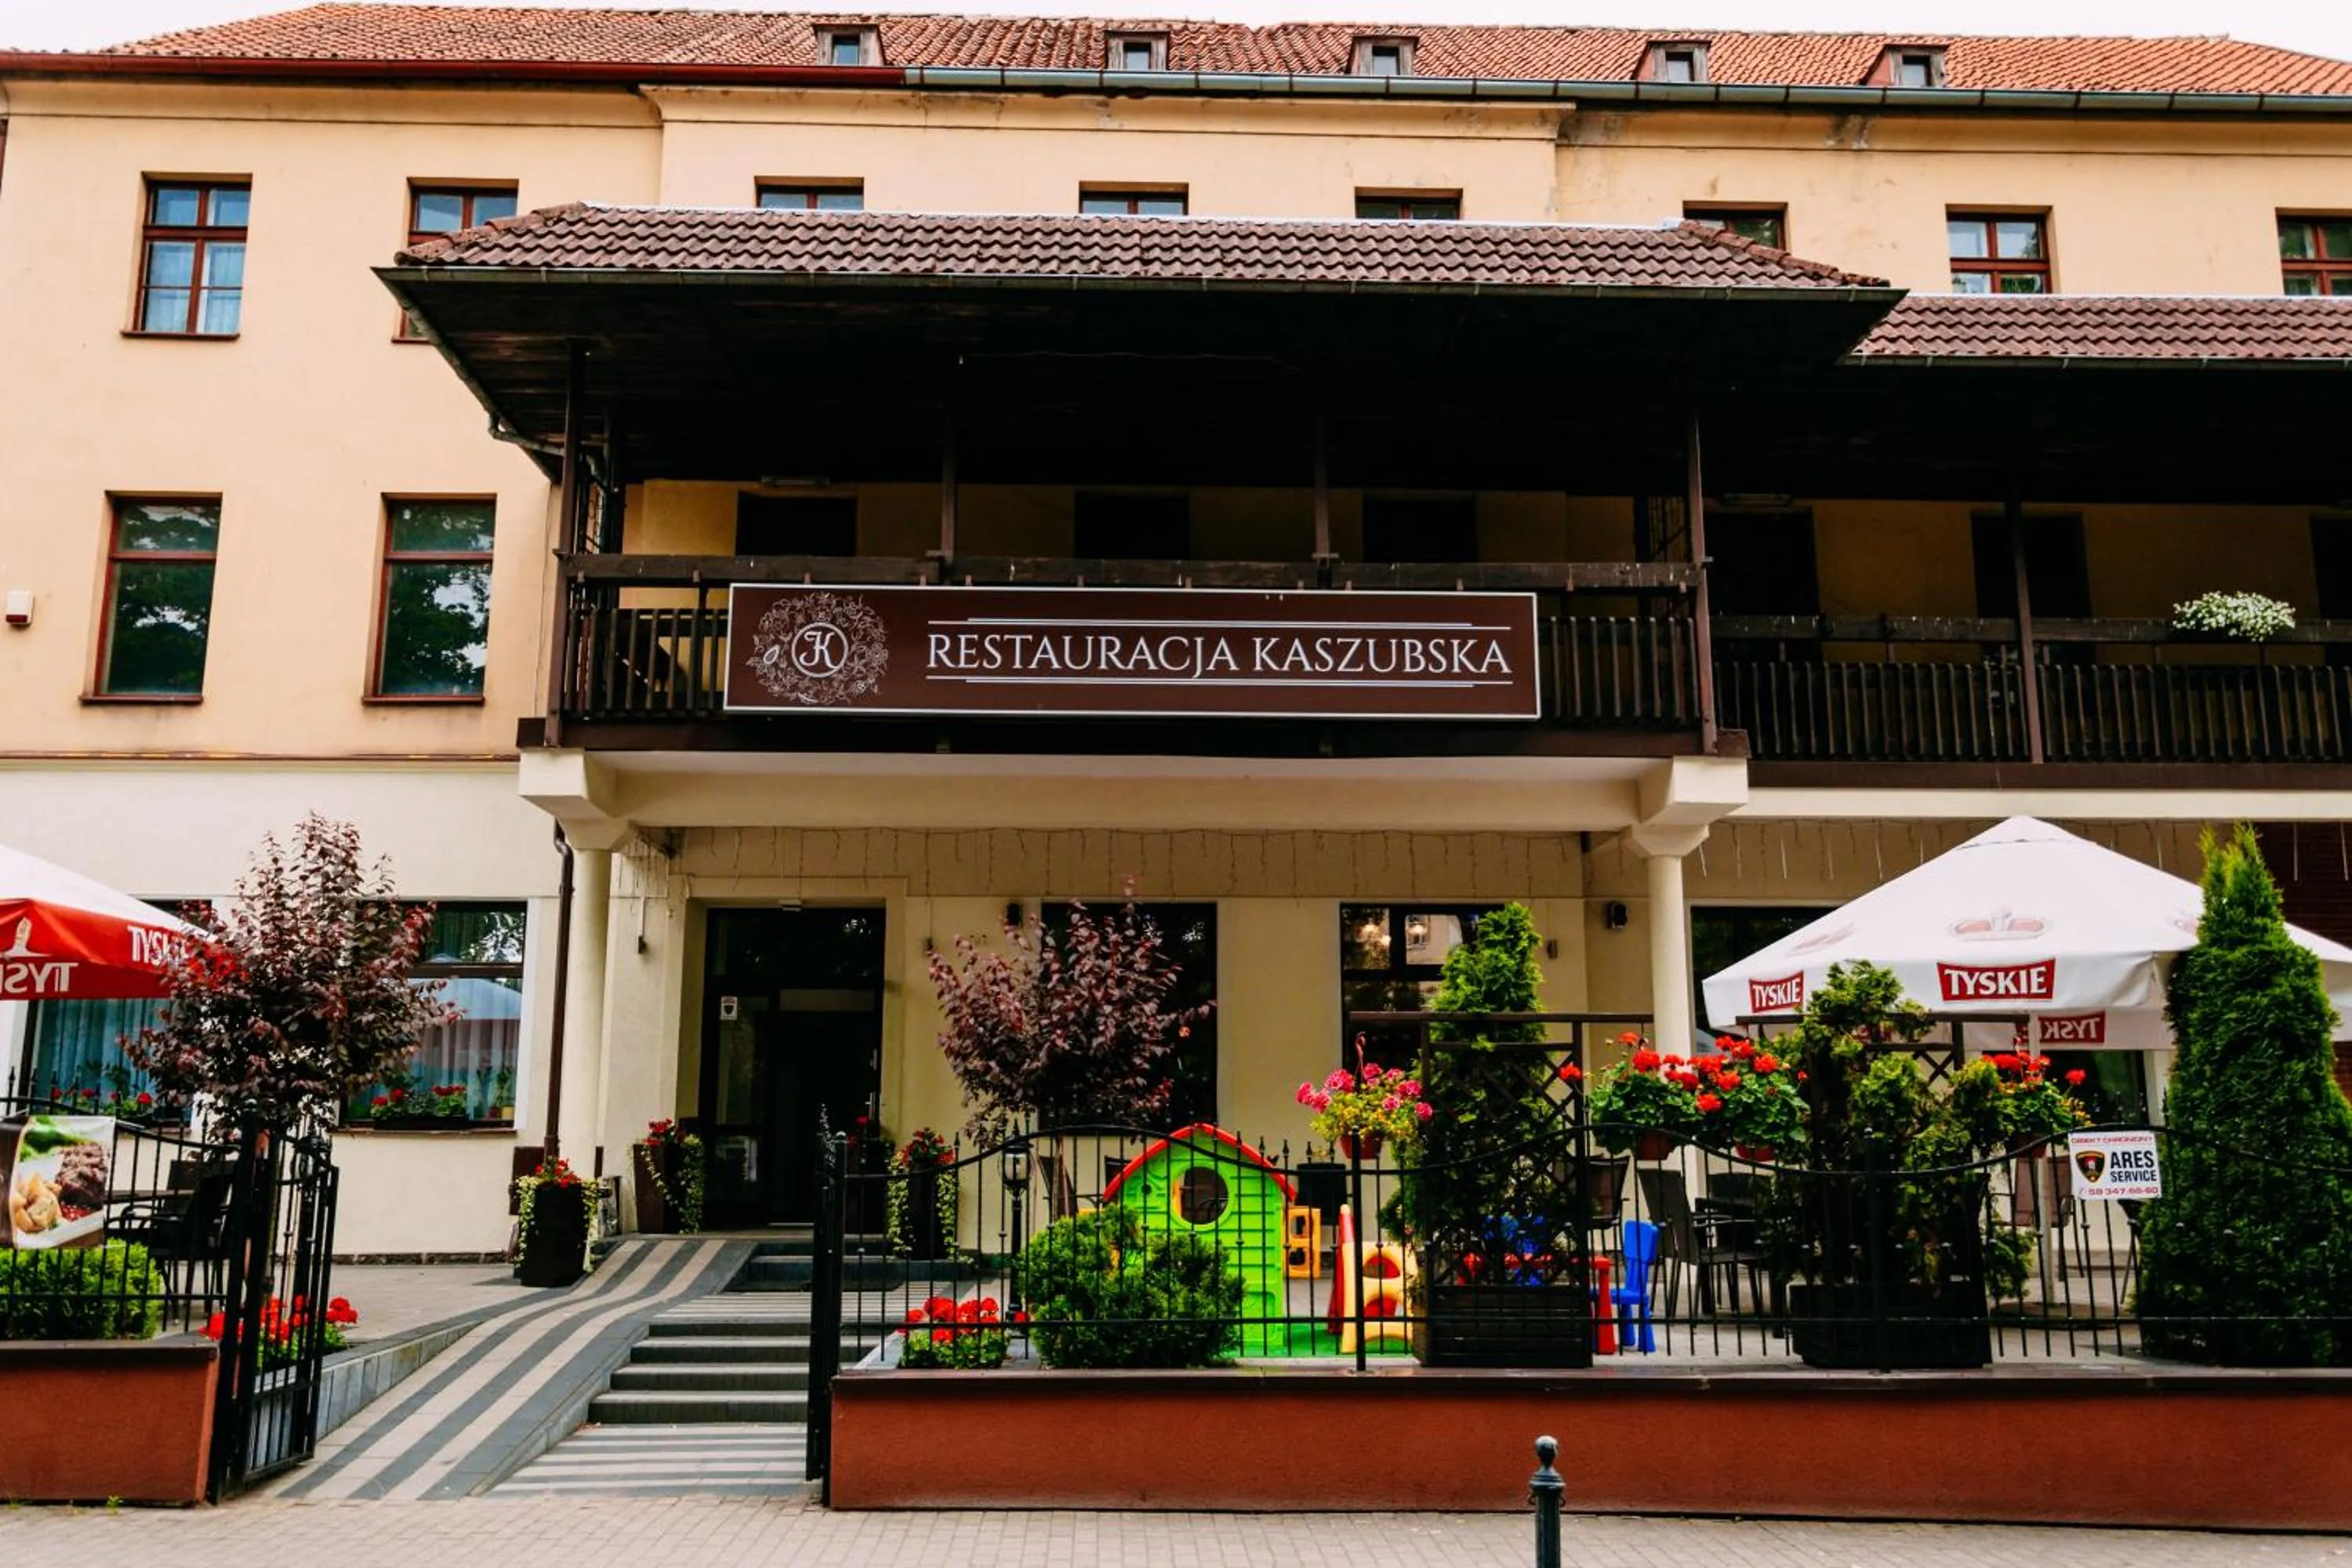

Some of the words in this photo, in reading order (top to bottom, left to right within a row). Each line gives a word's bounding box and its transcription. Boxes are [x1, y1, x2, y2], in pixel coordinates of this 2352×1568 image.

[927, 633, 1240, 679] RESTAURACJA
[1252, 637, 1514, 673] KASZUBSKA
[127, 925, 190, 968] TYSK
[1752, 978, 1801, 1007] TYSKIE
[1944, 965, 2047, 995] TYSKIE
[2110, 1150, 2155, 1169] ARES
[2110, 1170, 2158, 1183] SERVICE
